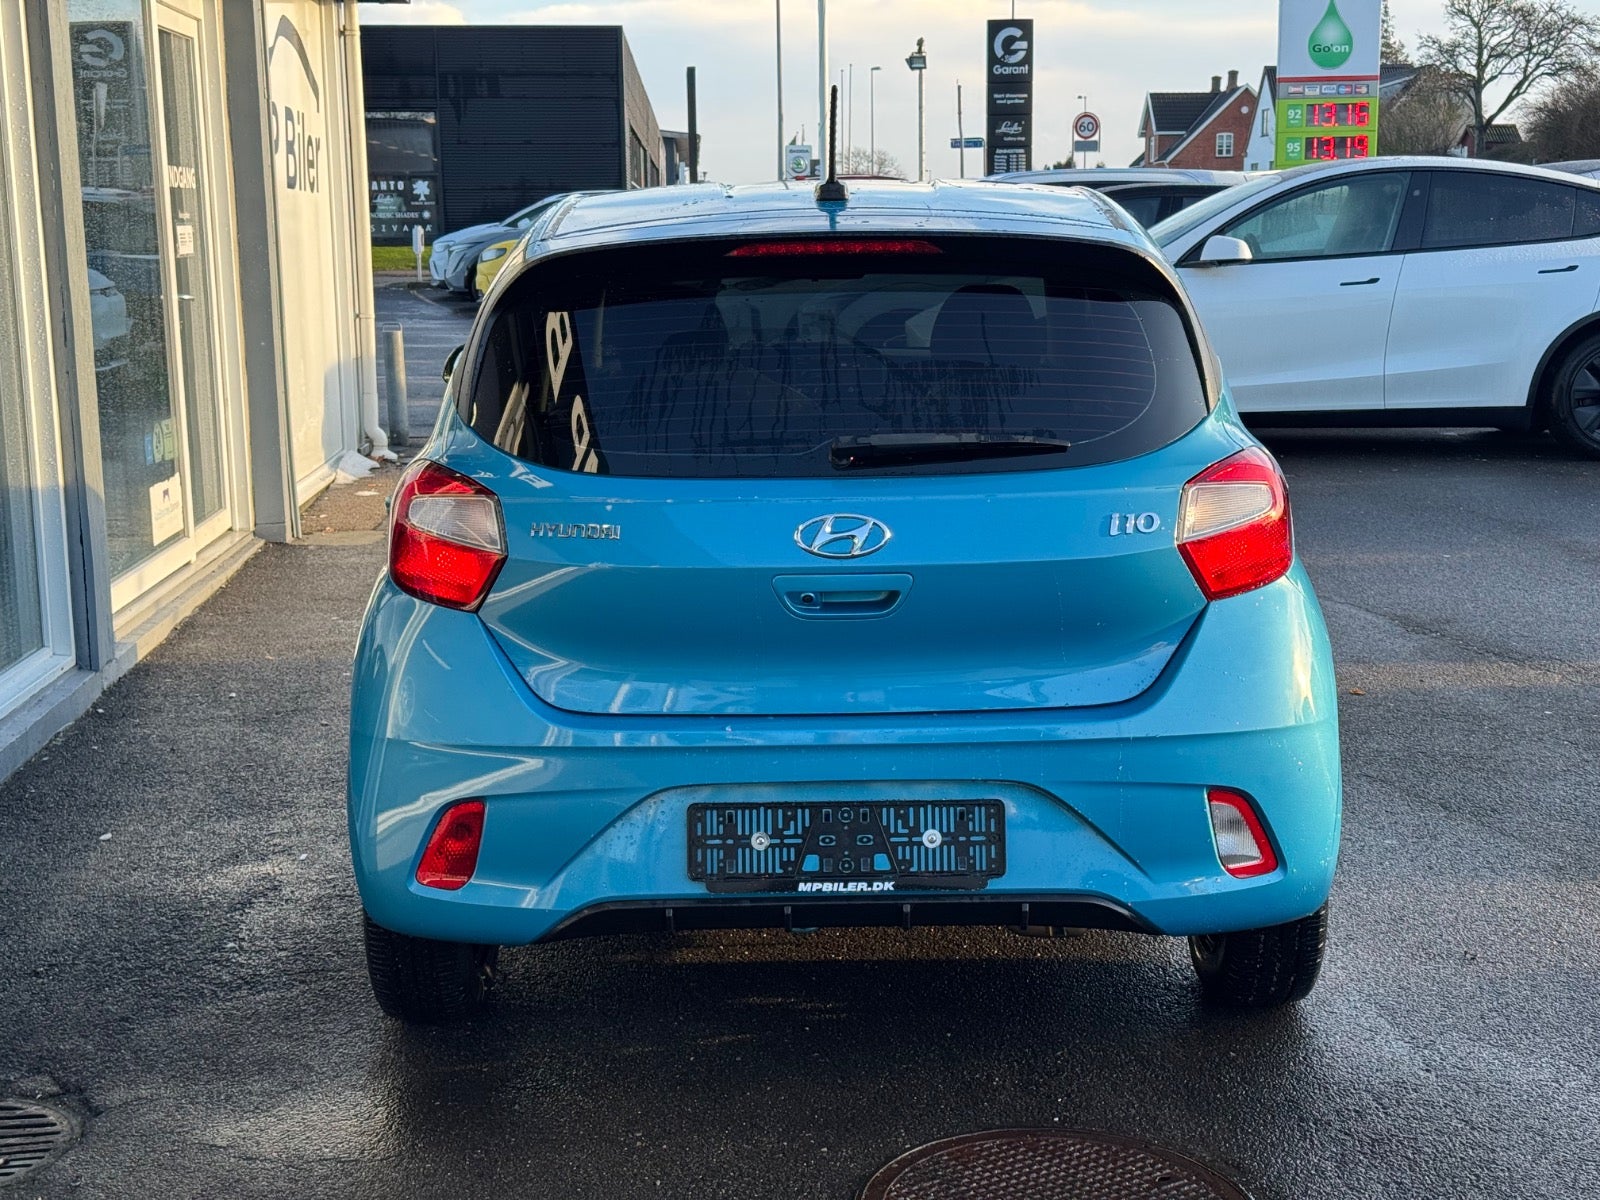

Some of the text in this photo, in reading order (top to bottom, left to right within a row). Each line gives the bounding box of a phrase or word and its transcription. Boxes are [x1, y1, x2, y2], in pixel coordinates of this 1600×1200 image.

[1312, 43, 1349, 53] Go'on
[992, 64, 1029, 75] Garant
[1287, 109, 1302, 119] 92
[1078, 121, 1094, 133] 60
[285, 105, 320, 193] Biler
[1286, 142, 1301, 153] 95
[1109, 512, 1161, 536] i10
[530, 522, 621, 539] HYUNDAI
[797, 881, 896, 892] MPBILER.DK
